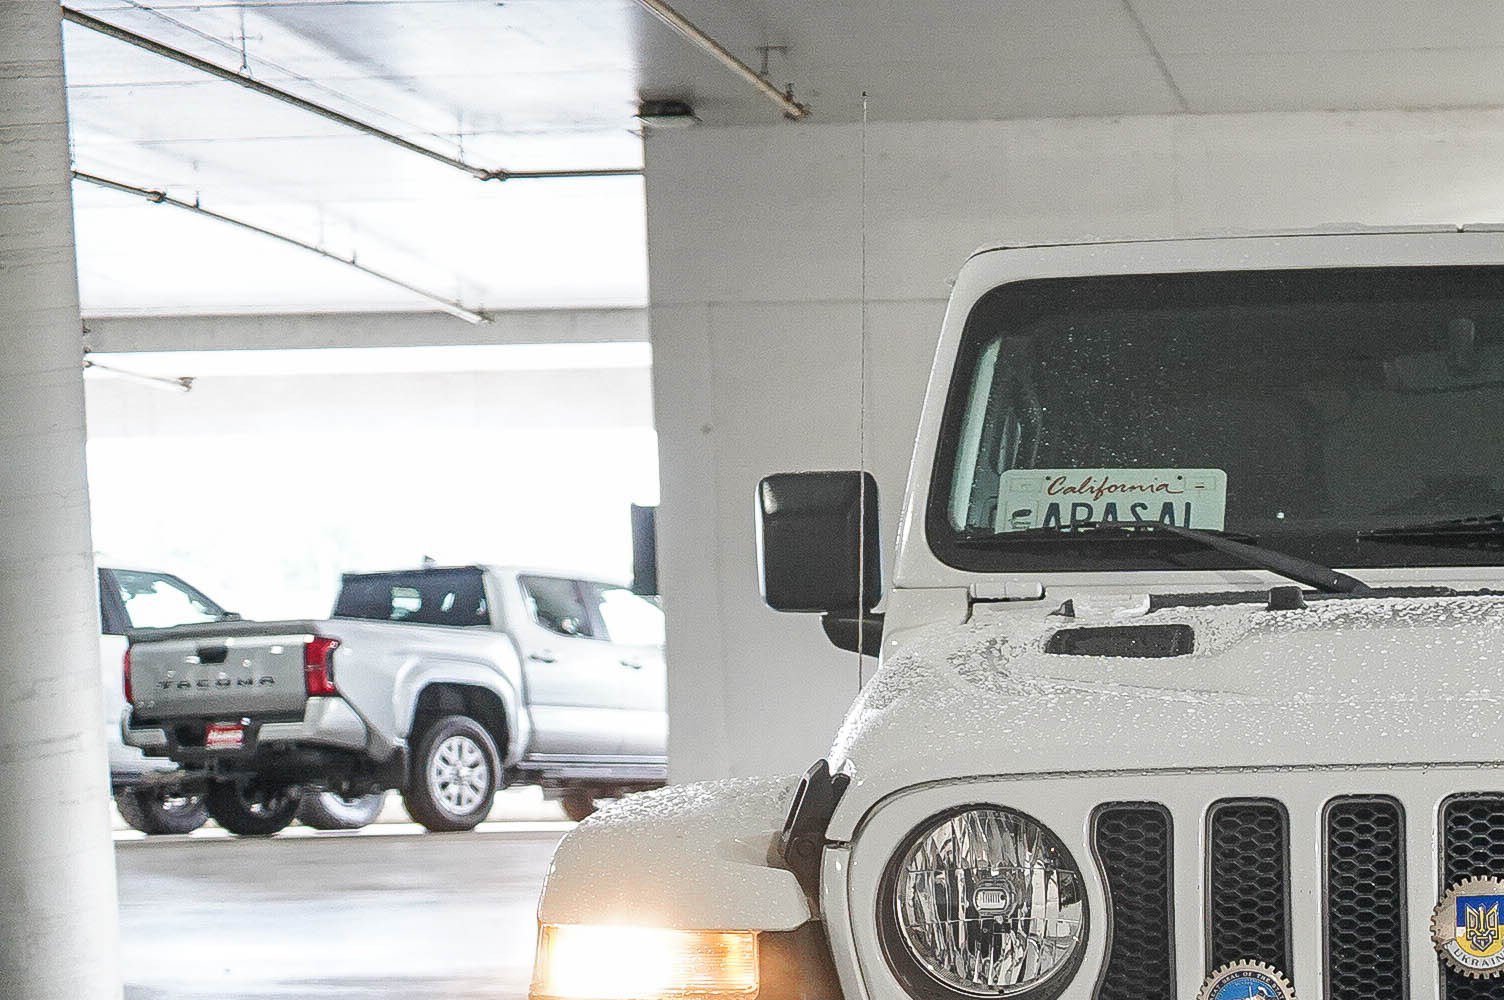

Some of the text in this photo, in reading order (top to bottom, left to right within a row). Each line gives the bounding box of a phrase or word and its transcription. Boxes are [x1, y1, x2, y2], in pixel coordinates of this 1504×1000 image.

[1047, 475, 1184, 501] California
[156, 675, 276, 690] TACOMA
[1256, 973, 1271, 983] THE
